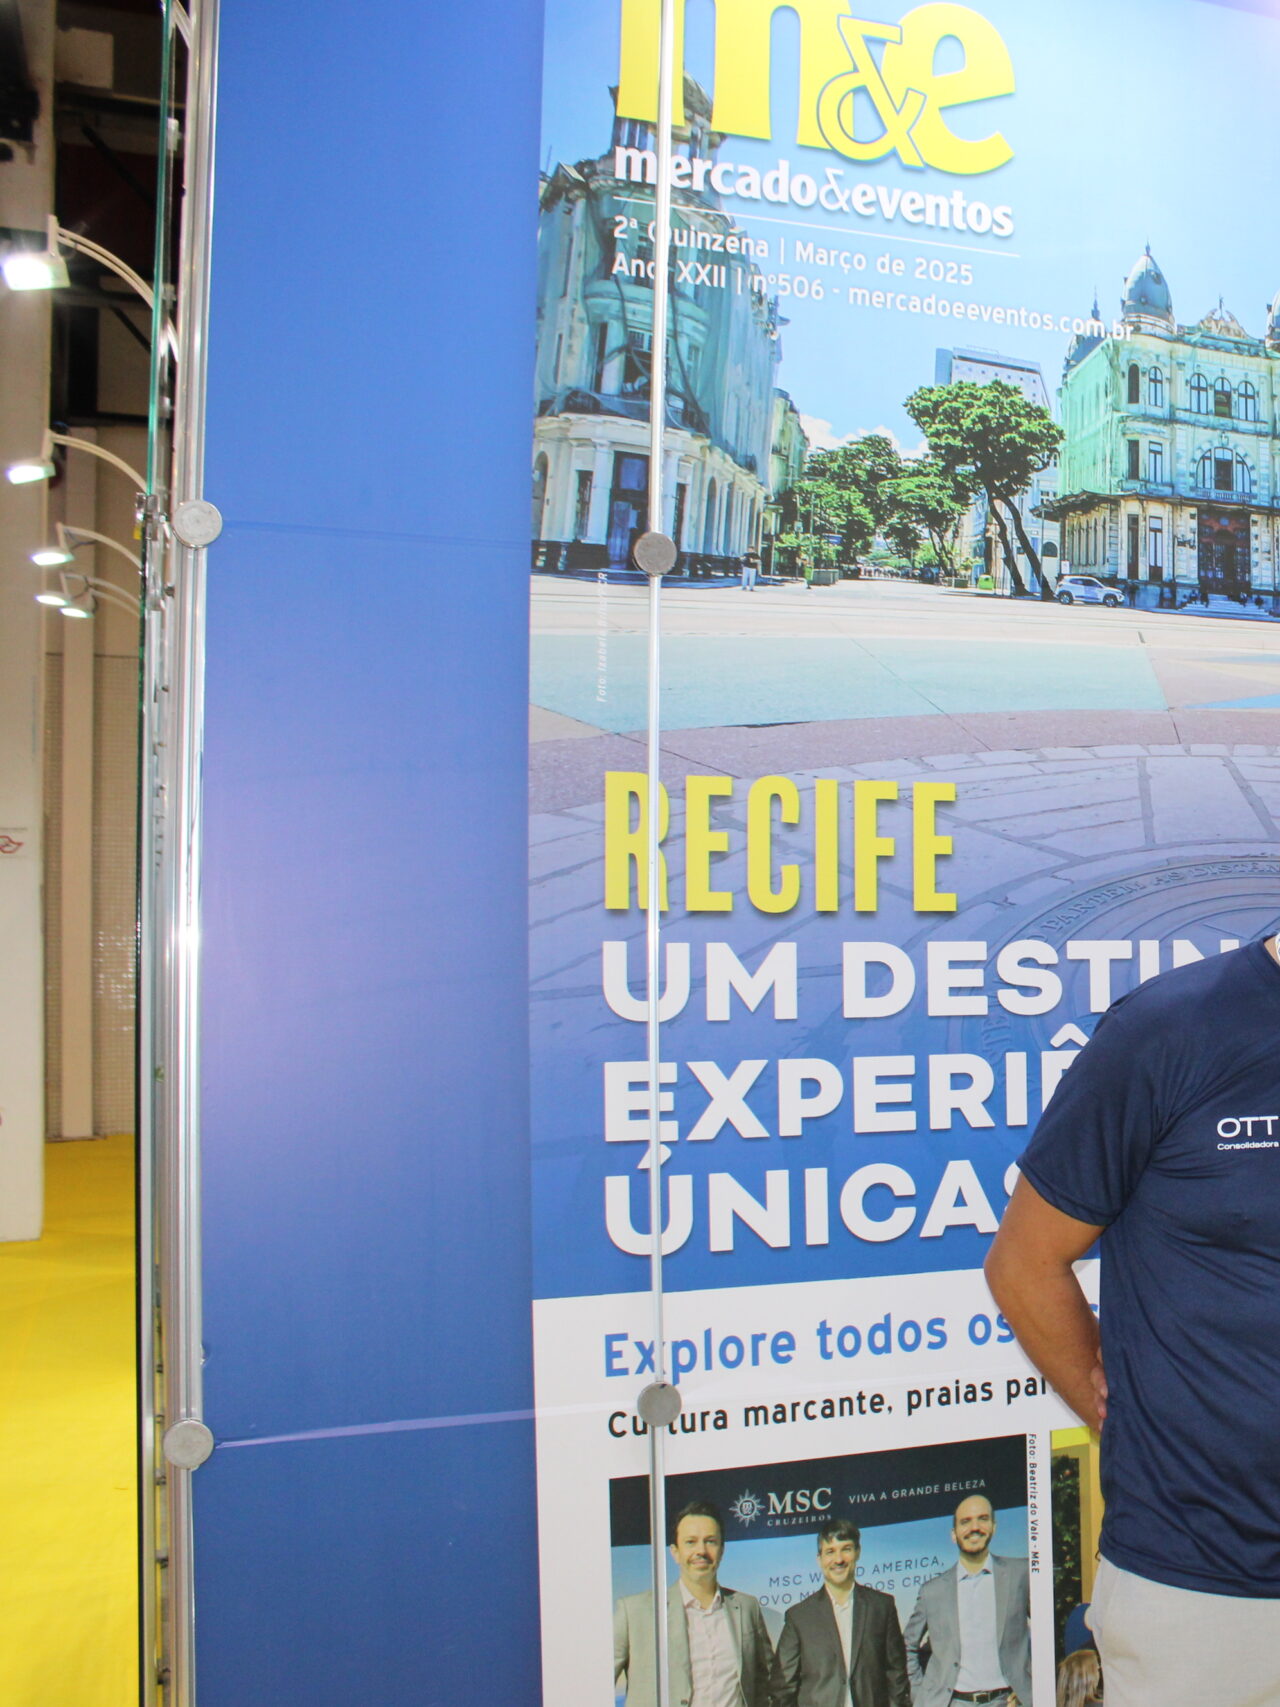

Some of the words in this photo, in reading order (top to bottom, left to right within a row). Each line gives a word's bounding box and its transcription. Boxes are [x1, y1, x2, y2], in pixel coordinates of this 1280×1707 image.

[614, 145, 1014, 237] mercado&eventos
[795, 240, 867, 276] Março
[876, 252, 906, 277] de
[915, 257, 975, 285] 2025
[677, 260, 727, 289] XXII
[848, 286, 1134, 342] mercadoeeventos.com.br
[604, 770, 958, 914] RECIFE
[603, 940, 798, 1022] UM
[1216, 1114, 1279, 1138] OTT
[1217, 1139, 1280, 1151] Consolidadora
[604, 1328, 797, 1386] Explore
[816, 1312, 947, 1362] todos
[608, 1409, 728, 1439] Cuura
[743, 1387, 893, 1427] marcante,
[907, 1378, 994, 1418] praias
[1028, 1433, 1037, 1460] Foto:
[767, 1486, 832, 1516] MSC
[849, 1492, 876, 1505] VIVA
[879, 1491, 888, 1500] A
[891, 1485, 940, 1499] GRANDE
[944, 1479, 987, 1493] BELEZA
[1029, 1462, 1039, 1500] Beatriz
[767, 1514, 832, 1527] CRUZEIROS
[1030, 1502, 1039, 1516] do
[1030, 1519, 1040, 1542] Vale
[769, 1574, 803, 1588] MSC
[872, 1555, 945, 1575] AMERICA,
[1031, 1551, 1041, 1574] M&E
